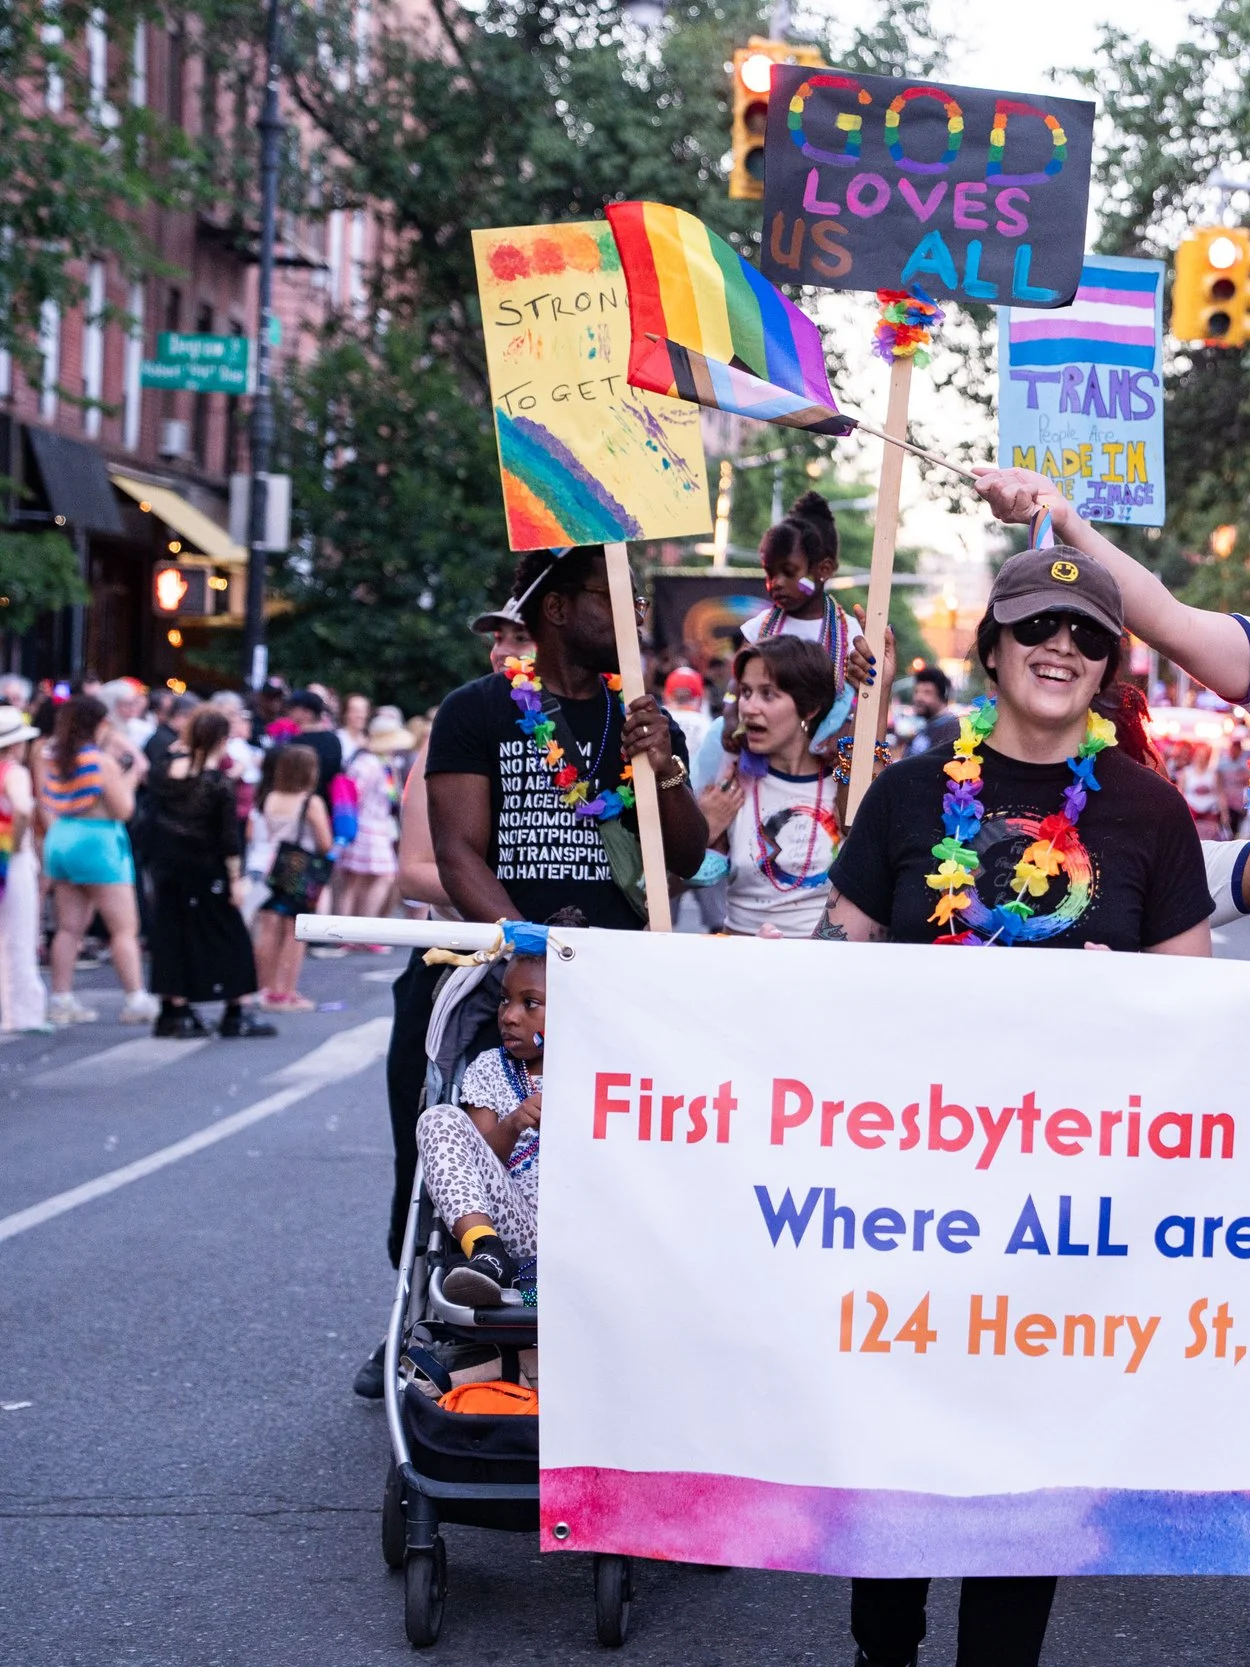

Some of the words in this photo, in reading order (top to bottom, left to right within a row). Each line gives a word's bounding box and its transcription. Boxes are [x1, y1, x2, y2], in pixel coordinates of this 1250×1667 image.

[787, 75, 1067, 187] GOD
[802, 167, 1030, 237] LOVES
[770, 210, 853, 278] US
[900, 229, 1060, 301] ALL
[495, 287, 631, 326] STRON
[498, 375, 645, 415] TOGET
[1009, 364, 1160, 421] TRANS
[1038, 413, 1080, 449] People
[1012, 446, 1094, 479] MADE
[1100, 441, 1149, 484] IN
[1085, 480, 1155, 505] IMAGE
[500, 758, 523, 775] NO
[501, 776, 522, 793] NO
[502, 794, 522, 810] NO
[499, 847, 514, 863] NO
[516, 845, 609, 863] TRANSPHO
[517, 828, 603, 846] FATPHOBI
[496, 864, 514, 880] NO
[516, 863, 613, 881] HATEFULN
[592, 1071, 738, 1144] First
[770, 1078, 1236, 1171] Presbyterian
[753, 1185, 982, 1254] Where
[1004, 1193, 1129, 1257] ALL
[839, 1289, 938, 1355] 124
[967, 1293, 1162, 1374] Henry
[1184, 1297, 1248, 1366] St,
